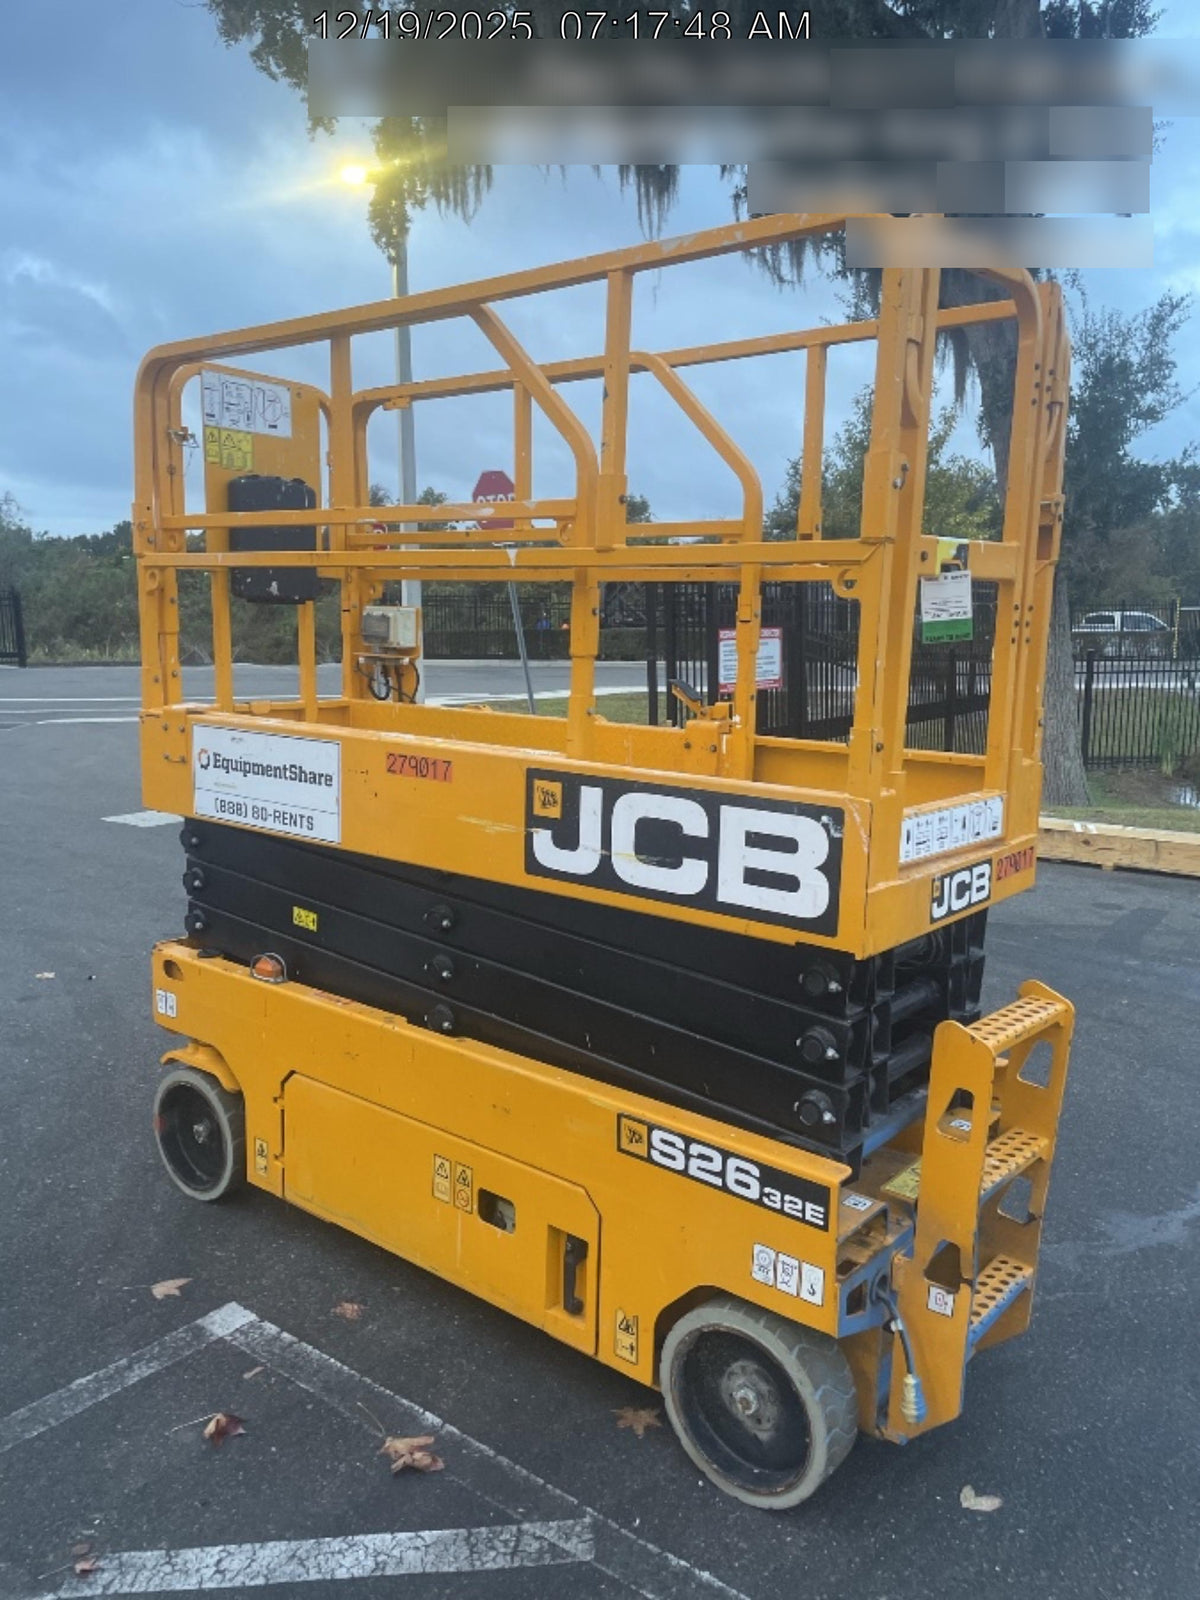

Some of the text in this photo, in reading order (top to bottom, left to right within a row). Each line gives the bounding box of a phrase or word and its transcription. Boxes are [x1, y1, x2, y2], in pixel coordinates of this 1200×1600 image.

[212, 751, 334, 787] EquipmentShare
[386, 752, 452, 781] 279017
[214, 797, 314, 831] (888) 80-RENTS
[531, 786, 830, 919] JCB
[932, 863, 991, 918] JCB
